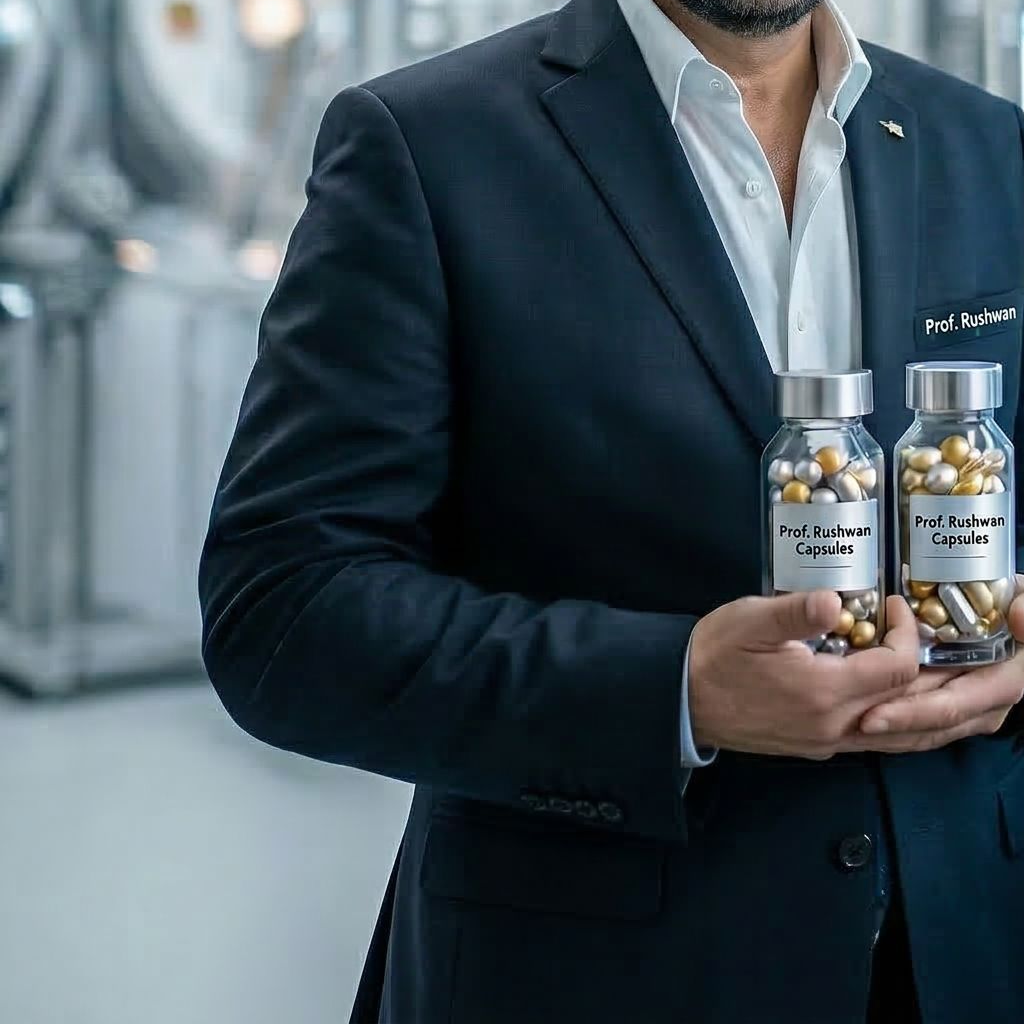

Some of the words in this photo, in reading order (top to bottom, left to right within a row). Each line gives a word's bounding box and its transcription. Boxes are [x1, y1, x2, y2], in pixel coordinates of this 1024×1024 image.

[925, 317, 958, 336] Prof.
[961, 305, 1017, 329] Rushwan
[915, 515, 945, 528] Prof.
[948, 513, 1005, 528] Rushwan
[779, 525, 811, 538] Prof.
[813, 525, 871, 539] Rushwan
[932, 532, 989, 549] Capsules
[795, 541, 854, 559] Capsules
